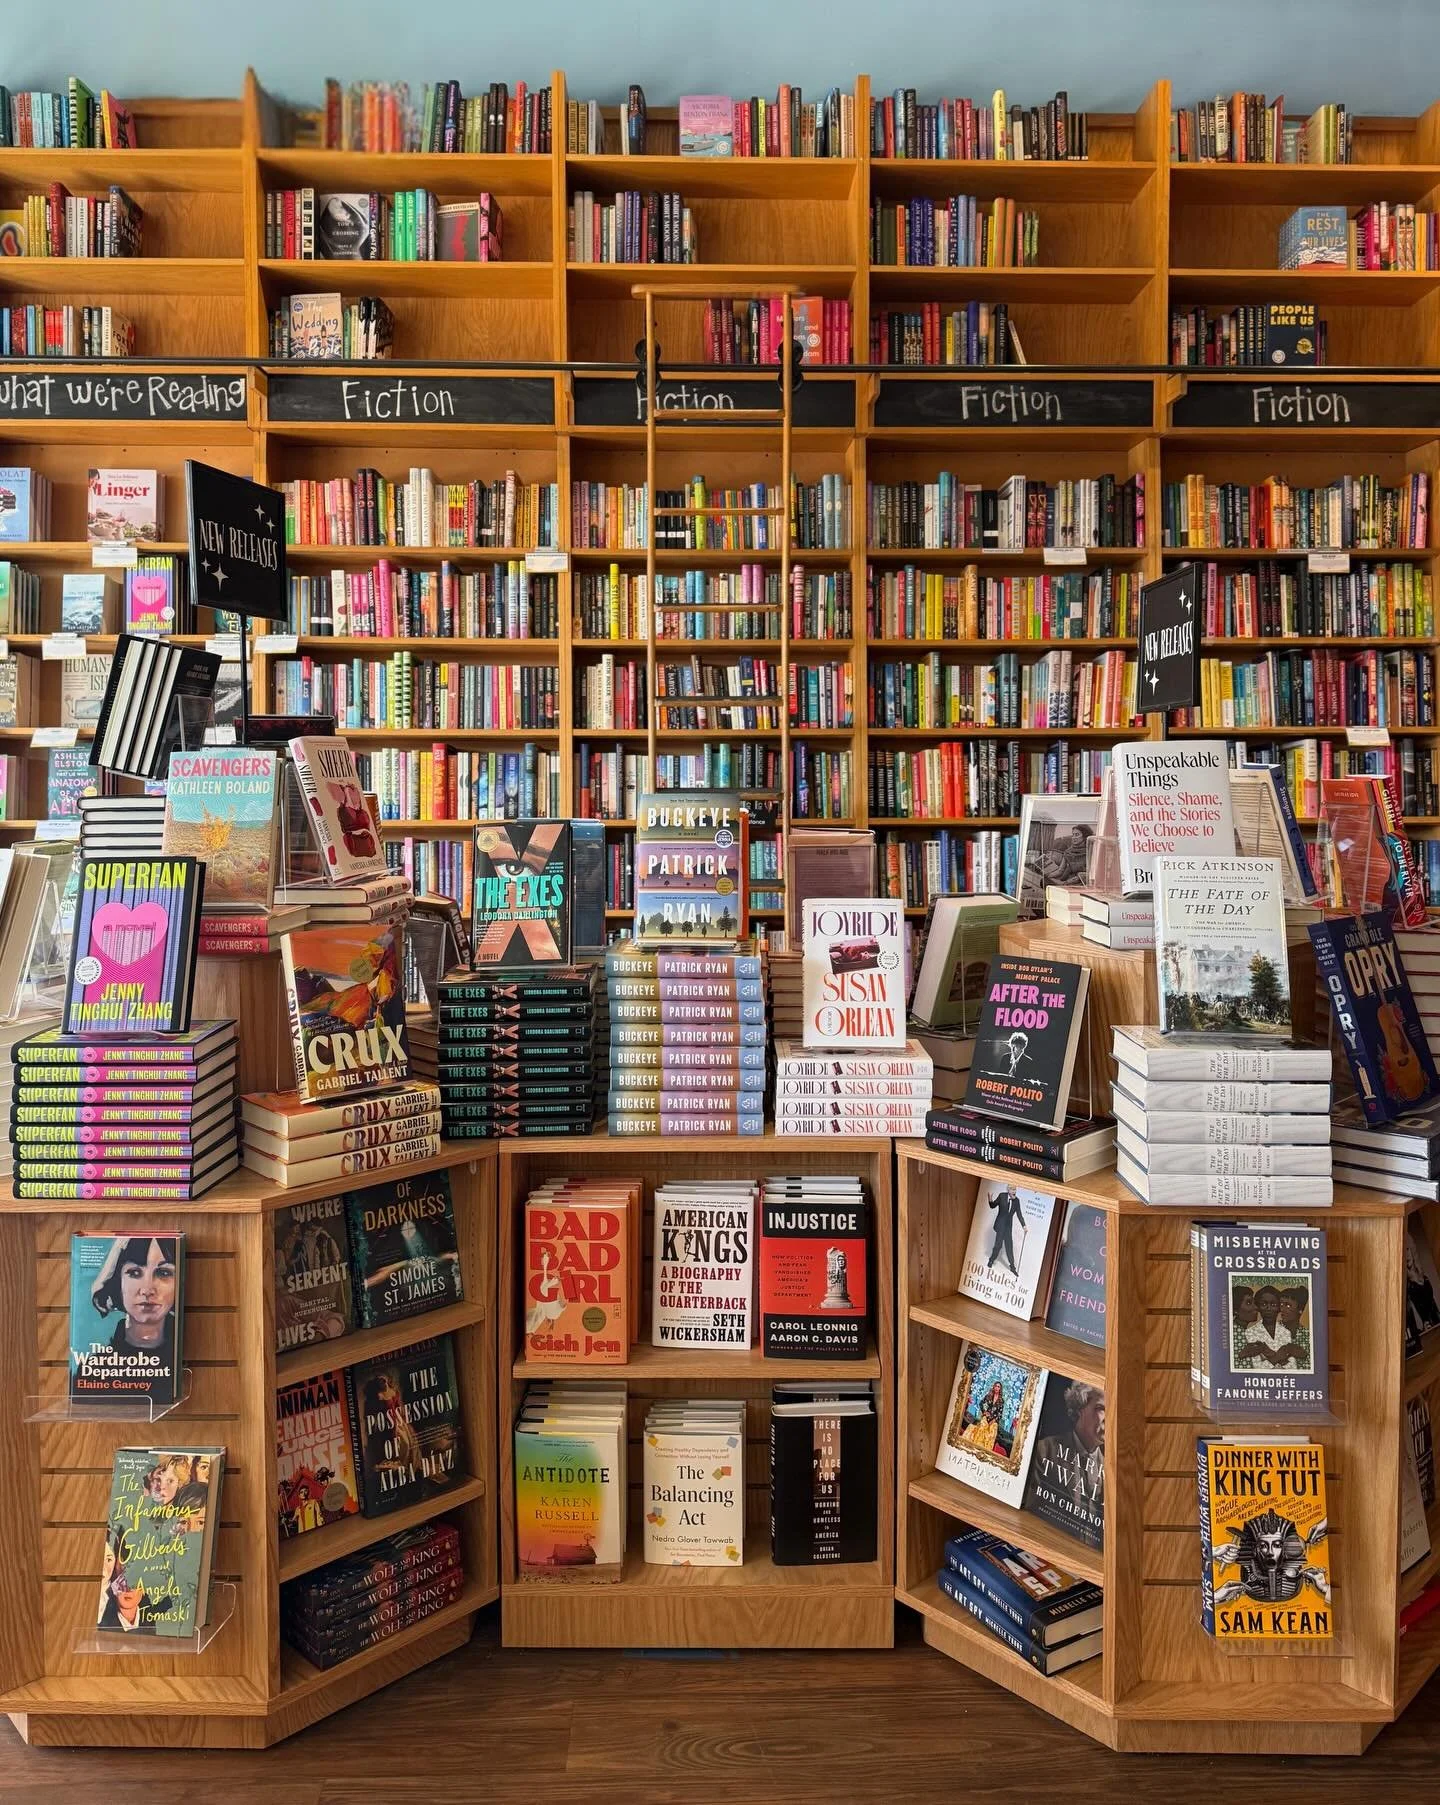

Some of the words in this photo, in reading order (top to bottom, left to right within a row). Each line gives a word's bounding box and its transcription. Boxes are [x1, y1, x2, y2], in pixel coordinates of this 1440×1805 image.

[1307, 218, 1340, 231] REST
[1270, 305, 1314, 315] PEOPLE
[291, 316, 339, 333] Wedding
[1270, 316, 1296, 326] LIKE
[1300, 316, 1314, 326] US
[148, 375, 246, 416] Reading
[341, 379, 454, 420] Fiction
[961, 384, 1063, 422] Fiction
[1252, 385, 1351, 423] Fiction
[95, 482, 150, 499] Linger
[199, 518, 226, 555] NEW
[229, 526, 278, 571] RELEASES
[1144, 629, 1160, 664] NEW
[1160, 620, 1193, 660] RELEASES
[64, 657, 110, 673] HUMAN-
[54, 752, 90, 761] ASHLEY
[54, 760, 89, 768] ELSTON
[318, 749, 355, 779] SHEER
[1126, 751, 1220, 773] Unspeakable
[171, 757, 271, 778] SCAVENGERS
[49, 778, 95, 787] ANATOMY
[169, 780, 221, 796] KATHLEEN
[225, 780, 270, 795] BOLAND
[1127, 771, 1179, 790] Things
[1128, 792, 1174, 807] Silence,
[1177, 791, 1222, 807] Shame,
[1279, 786, 1293, 820] Strangers
[1381, 789, 1397, 824] GILBERT
[647, 807, 730, 827] BUCKEYE
[1129, 808, 1153, 822] and
[1158, 807, 1176, 821] the
[1180, 807, 1220, 821] Stories
[1131, 824, 1149, 837] We
[1154, 823, 1198, 837] Choose
[1202, 823, 1214, 836] to
[1132, 839, 1175, 854] Believe
[648, 854, 728, 875] PATRICK
[1163, 861, 1196, 871] RICK
[1202, 861, 1274, 872] ATKINSON
[83, 862, 187, 890] SUPERFAN
[476, 876, 511, 909] THE
[516, 874, 564, 908] EXES
[1168, 888, 1199, 899] THE
[1207, 889, 1244, 900] FATE
[1251, 890, 1270, 900] OF
[663, 902, 711, 923] RYAN
[1184, 904, 1215, 915] THE
[1222, 904, 1255, 915] DAY
[812, 910, 898, 937] JOYRIDE
[1000, 962, 1018, 972] INSIDE
[1018, 964, 1030, 973] BOB
[1030, 966, 1053, 975] DYLAN'S
[1344, 943, 1402, 998] OPRY
[822, 972, 887, 1003] SUSAN
[1015, 973, 1039, 982] MEMORY
[1040, 975, 1061, 985] PALACE
[101, 983, 145, 1001] JENNY
[989, 983, 1041, 1005] AFTER
[1042, 992, 1066, 1009] THE
[71, 1002, 124, 1021] TINGHUI
[127, 1002, 173, 1020] ZHANG
[994, 1007, 1049, 1030] FLOOD
[814, 1005, 895, 1037] ORLEAN
[308, 1024, 409, 1074] CRUX
[316, 1071, 362, 1091] GABRIEL
[363, 1064, 409, 1083] TALLENT
[975, 1078, 1008, 1095] ROBERT
[1010, 1085, 1043, 1102] POLITO
[396, 1181, 411, 1199] OF
[363, 1193, 447, 1232] DARKNESS
[662, 1209, 748, 1229] AMERICAN
[768, 1212, 857, 1231] INJUSTICE
[529, 1210, 621, 1241] BAD
[1213, 1235, 1320, 1250] MISBEHAVING
[529, 1241, 621, 1272] BAD
[1214, 1256, 1321, 1270] CROSSROADS
[389, 1260, 438, 1287] SIMONE
[660, 1266, 671, 1279] A
[671, 1267, 742, 1282] BIOGRAPHY
[966, 1259, 985, 1278] 100
[986, 1267, 1017, 1290] Rules
[1017, 1284, 1030, 1296] for
[384, 1290, 404, 1306] ST.
[407, 1276, 447, 1299] JAMES
[660, 1280, 677, 1293] OF
[678, 1281, 703, 1294] THE
[962, 1274, 993, 1299] Living
[994, 1291, 1003, 1301] to
[1004, 1291, 1026, 1310] 100
[660, 1294, 747, 1310] QUARTERBACK
[713, 1313, 746, 1327] SETH
[769, 1321, 807, 1331] CAROL
[810, 1322, 858, 1332] LEONNIG
[659, 1326, 746, 1343] WICKERSHAM
[769, 1333, 809, 1343] AARON
[812, 1334, 824, 1344] C.
[825, 1334, 858, 1344] DAVIS
[89, 1342, 114, 1354] The
[529, 1333, 579, 1352] Gish
[584, 1335, 621, 1356] Jen
[73, 1350, 160, 1367] Wardrobe
[81, 1365, 171, 1380] Department
[1244, 1375, 1296, 1388] HONORÉE
[77, 1378, 110, 1389] Elaine
[112, 1379, 152, 1391] Garvey
[1217, 1388, 1270, 1399] FANONNE
[1274, 1389, 1323, 1400] JEFFERS
[813, 1420, 841, 1430] THERE
[822, 1433, 832, 1442] IS
[821, 1445, 833, 1455] NO
[1214, 1450, 1273, 1468] DINNER
[1277, 1451, 1319, 1468] WITH
[676, 1465, 704, 1480] The
[813, 1459, 841, 1469] PLACE
[119, 1474, 141, 1492] The
[522, 1466, 610, 1484] ANTIDOTE
[818, 1471, 836, 1481] FOR
[1215, 1470, 1272, 1496] KING
[1276, 1470, 1320, 1497] TUT
[651, 1484, 734, 1508] Balancing
[821, 1484, 833, 1494] US
[540, 1497, 593, 1508] KAREN
[113, 1494, 201, 1531] Infamous
[535, 1510, 600, 1521] RUSSELL
[678, 1509, 706, 1526] Act
[118, 1528, 191, 1565] Gilberts
[651, 1535, 675, 1544] Nedra
[677, 1535, 701, 1544] Glover
[703, 1535, 734, 1544] Tawwab
[135, 1576, 182, 1604] Angela
[138, 1604, 190, 1623] Tomaski
[1220, 1610, 1265, 1634] SAM
[1272, 1611, 1329, 1635] KEAN
